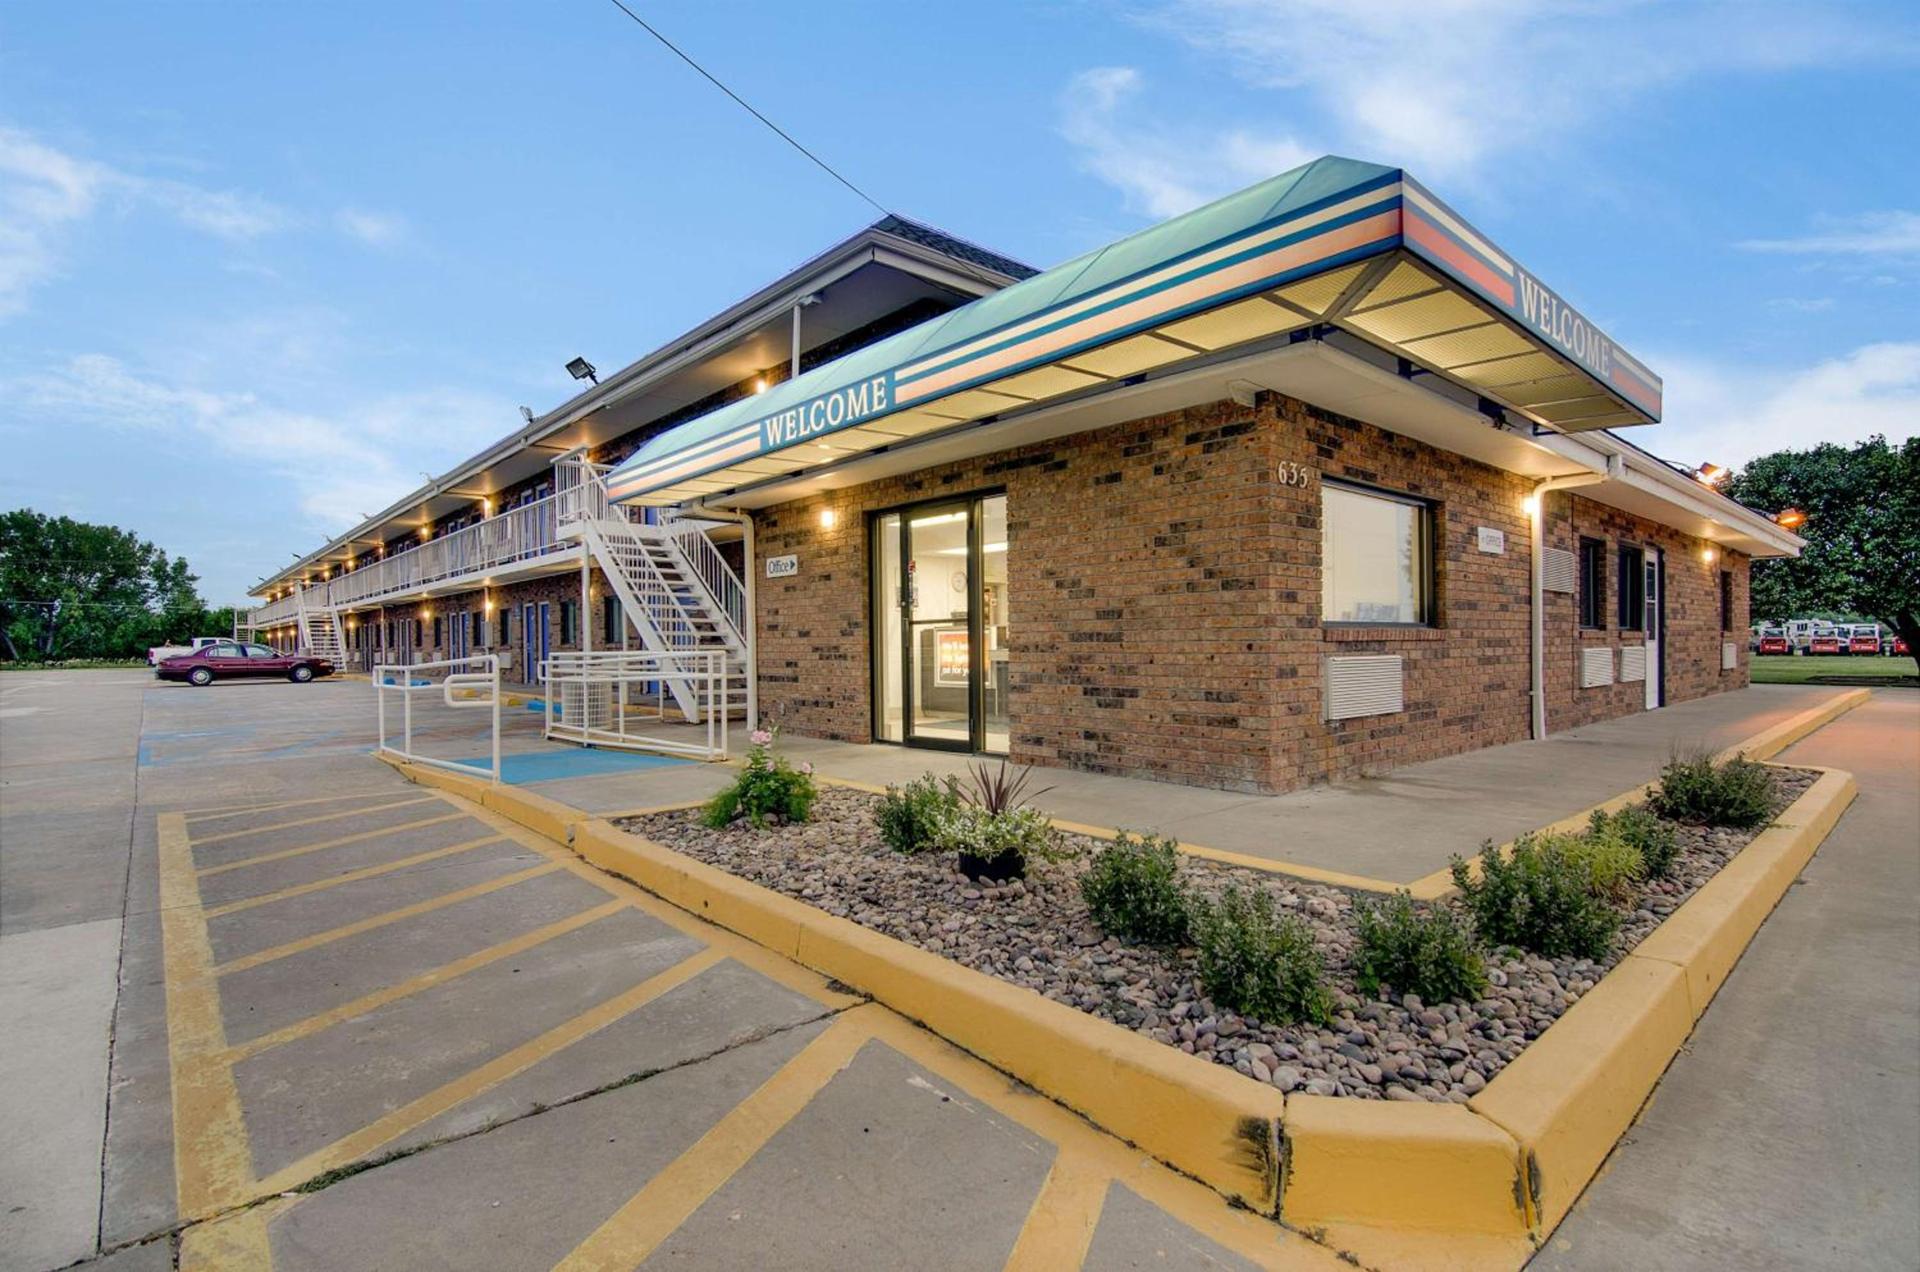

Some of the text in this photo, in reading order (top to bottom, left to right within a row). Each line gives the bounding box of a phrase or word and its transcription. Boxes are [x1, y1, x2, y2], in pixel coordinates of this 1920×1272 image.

[1519, 272, 1610, 378] WELCOME
[765, 376, 887, 447] WELCOME
[1278, 461, 1308, 488] 635
[768, 560, 789, 574] Office
